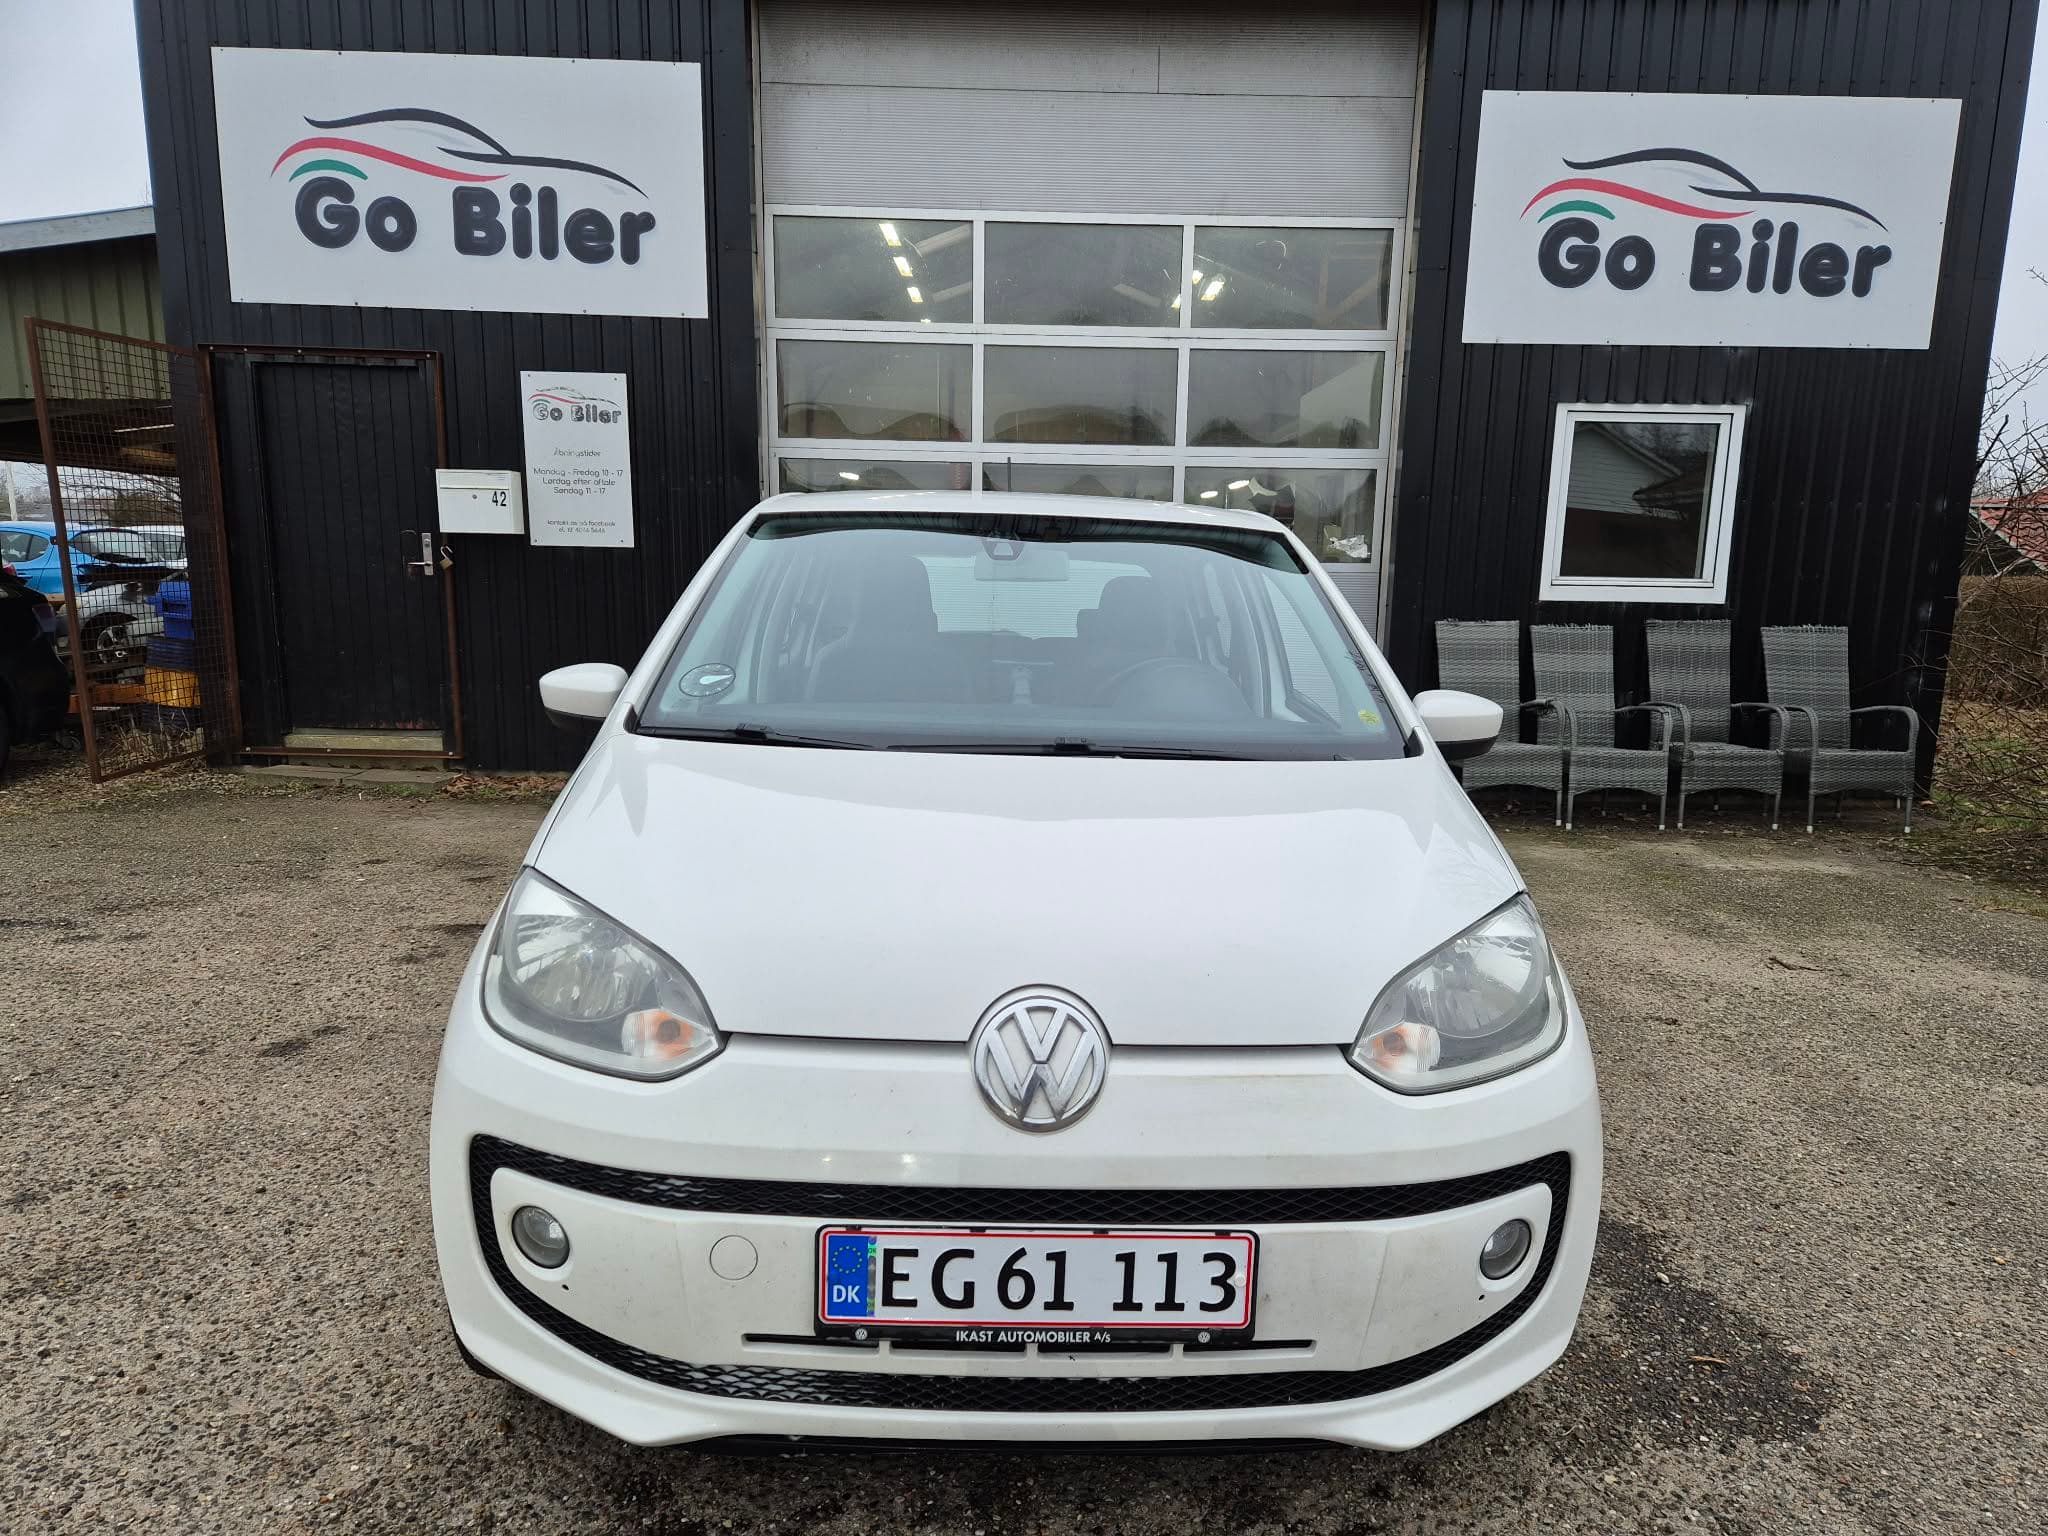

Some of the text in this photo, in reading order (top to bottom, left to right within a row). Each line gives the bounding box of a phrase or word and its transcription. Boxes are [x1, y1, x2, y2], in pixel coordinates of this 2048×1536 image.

[294, 176, 656, 265] Go Biler
[1537, 217, 1892, 298] Go Biler
[533, 403, 622, 424] Go Biler
[533, 468, 566, 477] Mandag
[573, 468, 600, 478] Fredag
[594, 478, 616, 486] aftale
[492, 491, 507, 507] 42
[881, 1247, 1238, 1312] EG 61 113
[832, 1284, 861, 1304] DK
[956, 1330, 994, 1342] IKAST
[997, 1330, 1091, 1343] AUTOMOBILER
